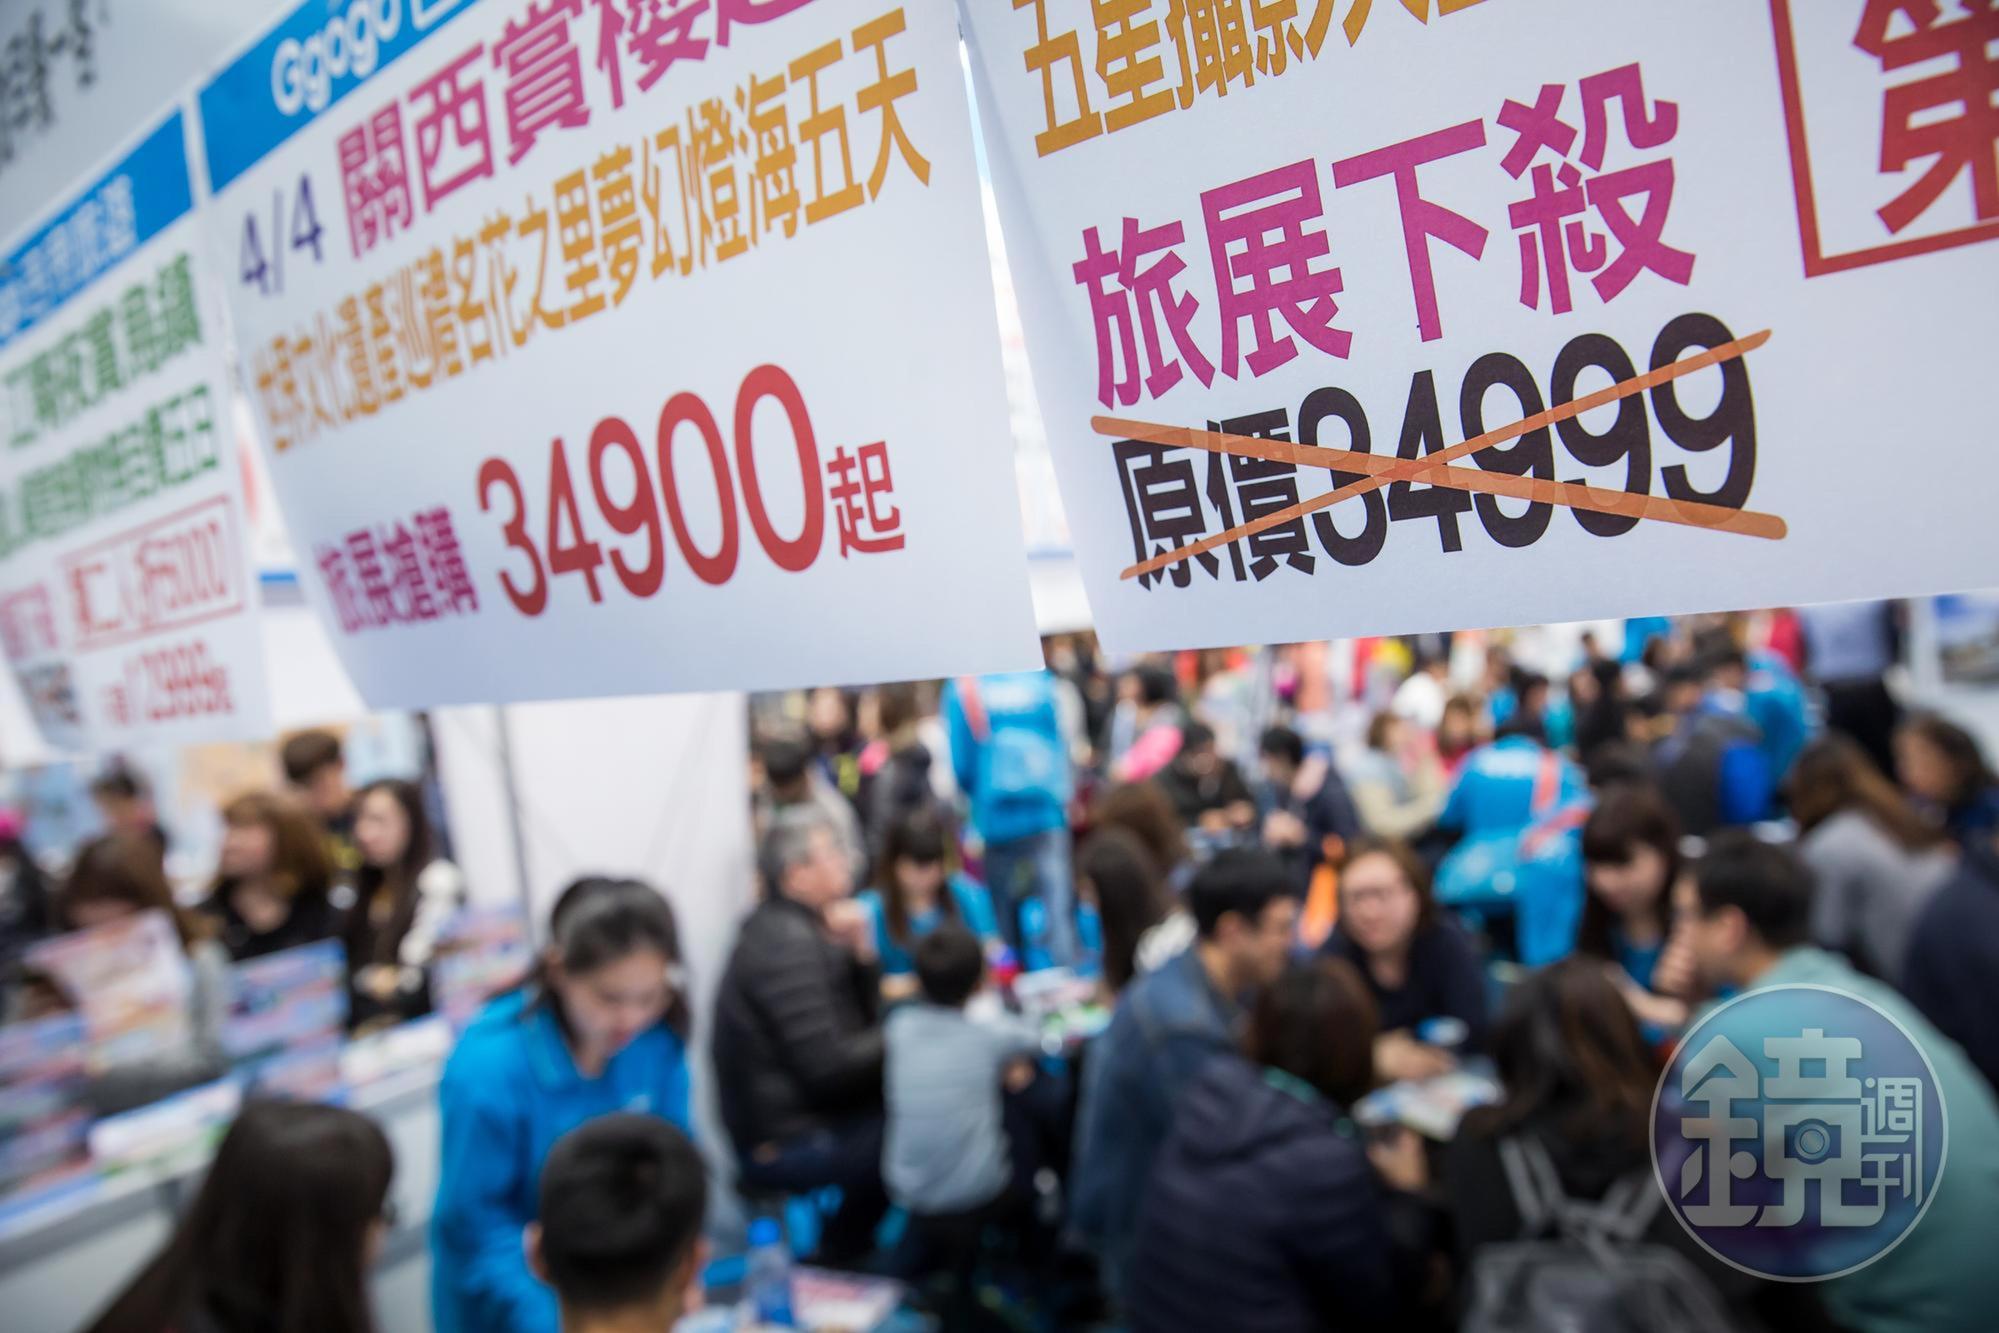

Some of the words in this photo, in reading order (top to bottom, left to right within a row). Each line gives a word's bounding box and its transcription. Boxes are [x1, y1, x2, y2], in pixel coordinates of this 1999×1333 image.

[237, 171, 325, 296] 4/4
[336, 0, 816, 258] 關西賞櫻
[1072, 62, 1697, 409] 旅展下殺
